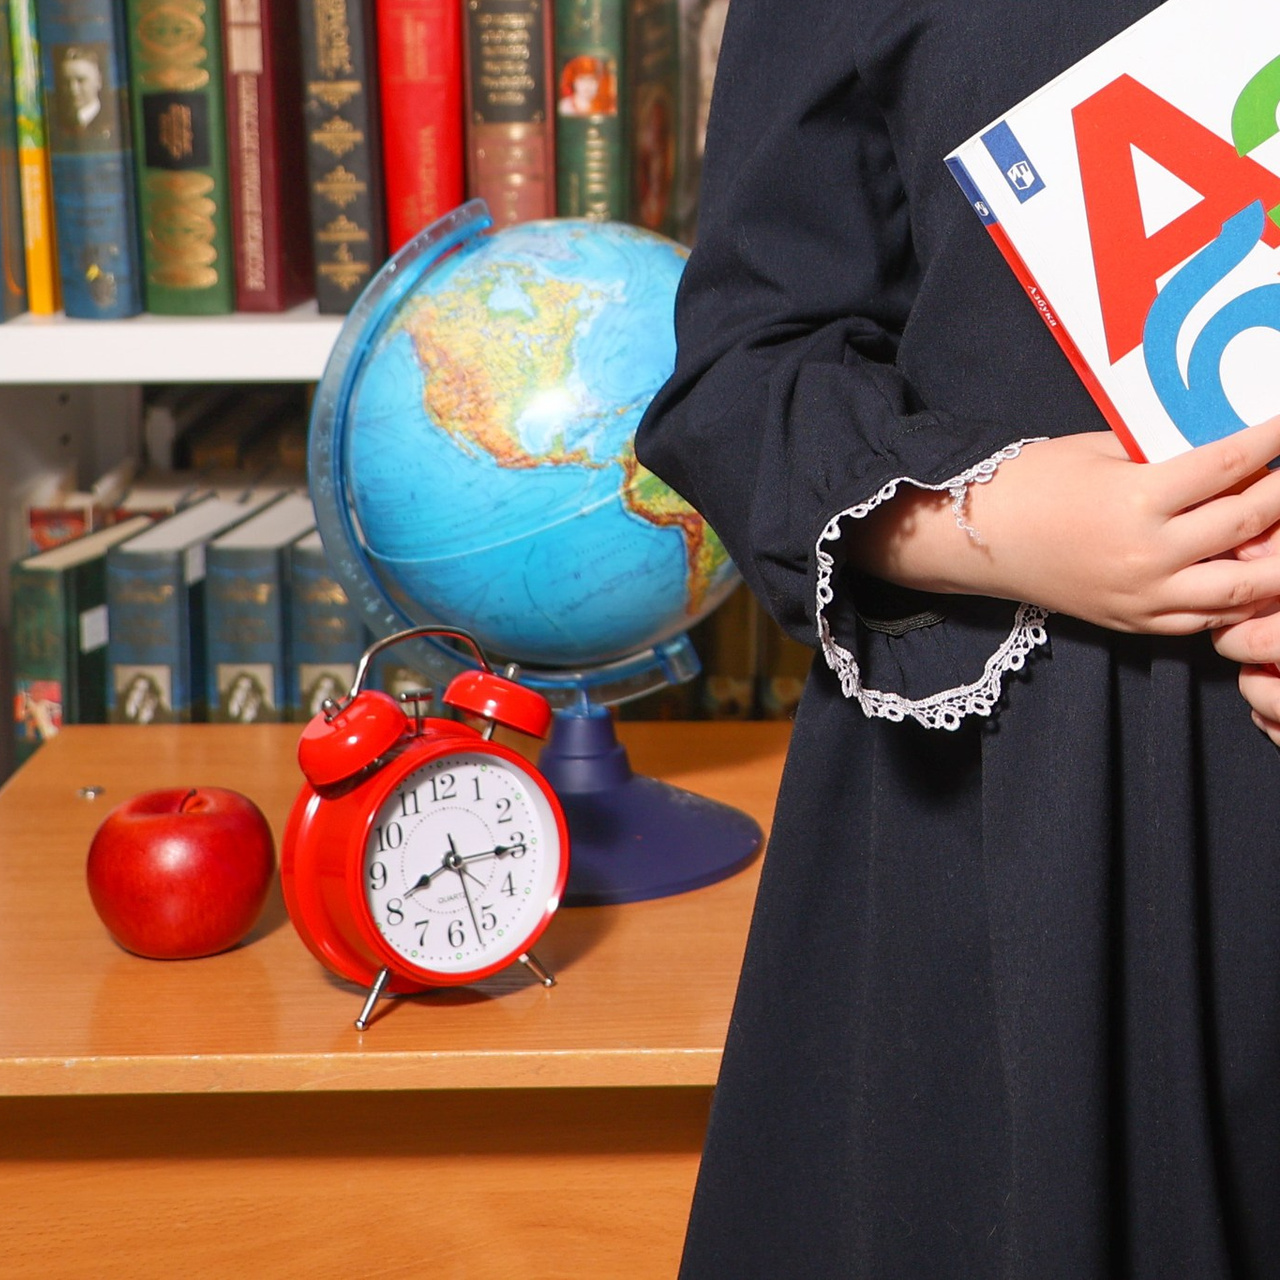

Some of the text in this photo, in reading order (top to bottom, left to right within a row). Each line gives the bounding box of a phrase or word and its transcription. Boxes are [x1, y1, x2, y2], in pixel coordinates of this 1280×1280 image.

[1027, 284, 1058, 328] Азбука
[428, 773, 457, 803] 12
[471, 776, 484, 802] 1
[399, 789, 422, 818] 11
[496, 797, 513, 824] 2
[375, 821, 403, 853] 10
[509, 831, 528, 859] 3
[369, 861, 388, 891] 9
[499, 870, 517, 898] 4
[386, 897, 405, 926] 8
[481, 903, 498, 931] 5
[414, 919, 430, 947] 7
[447, 919, 465, 948] 6
